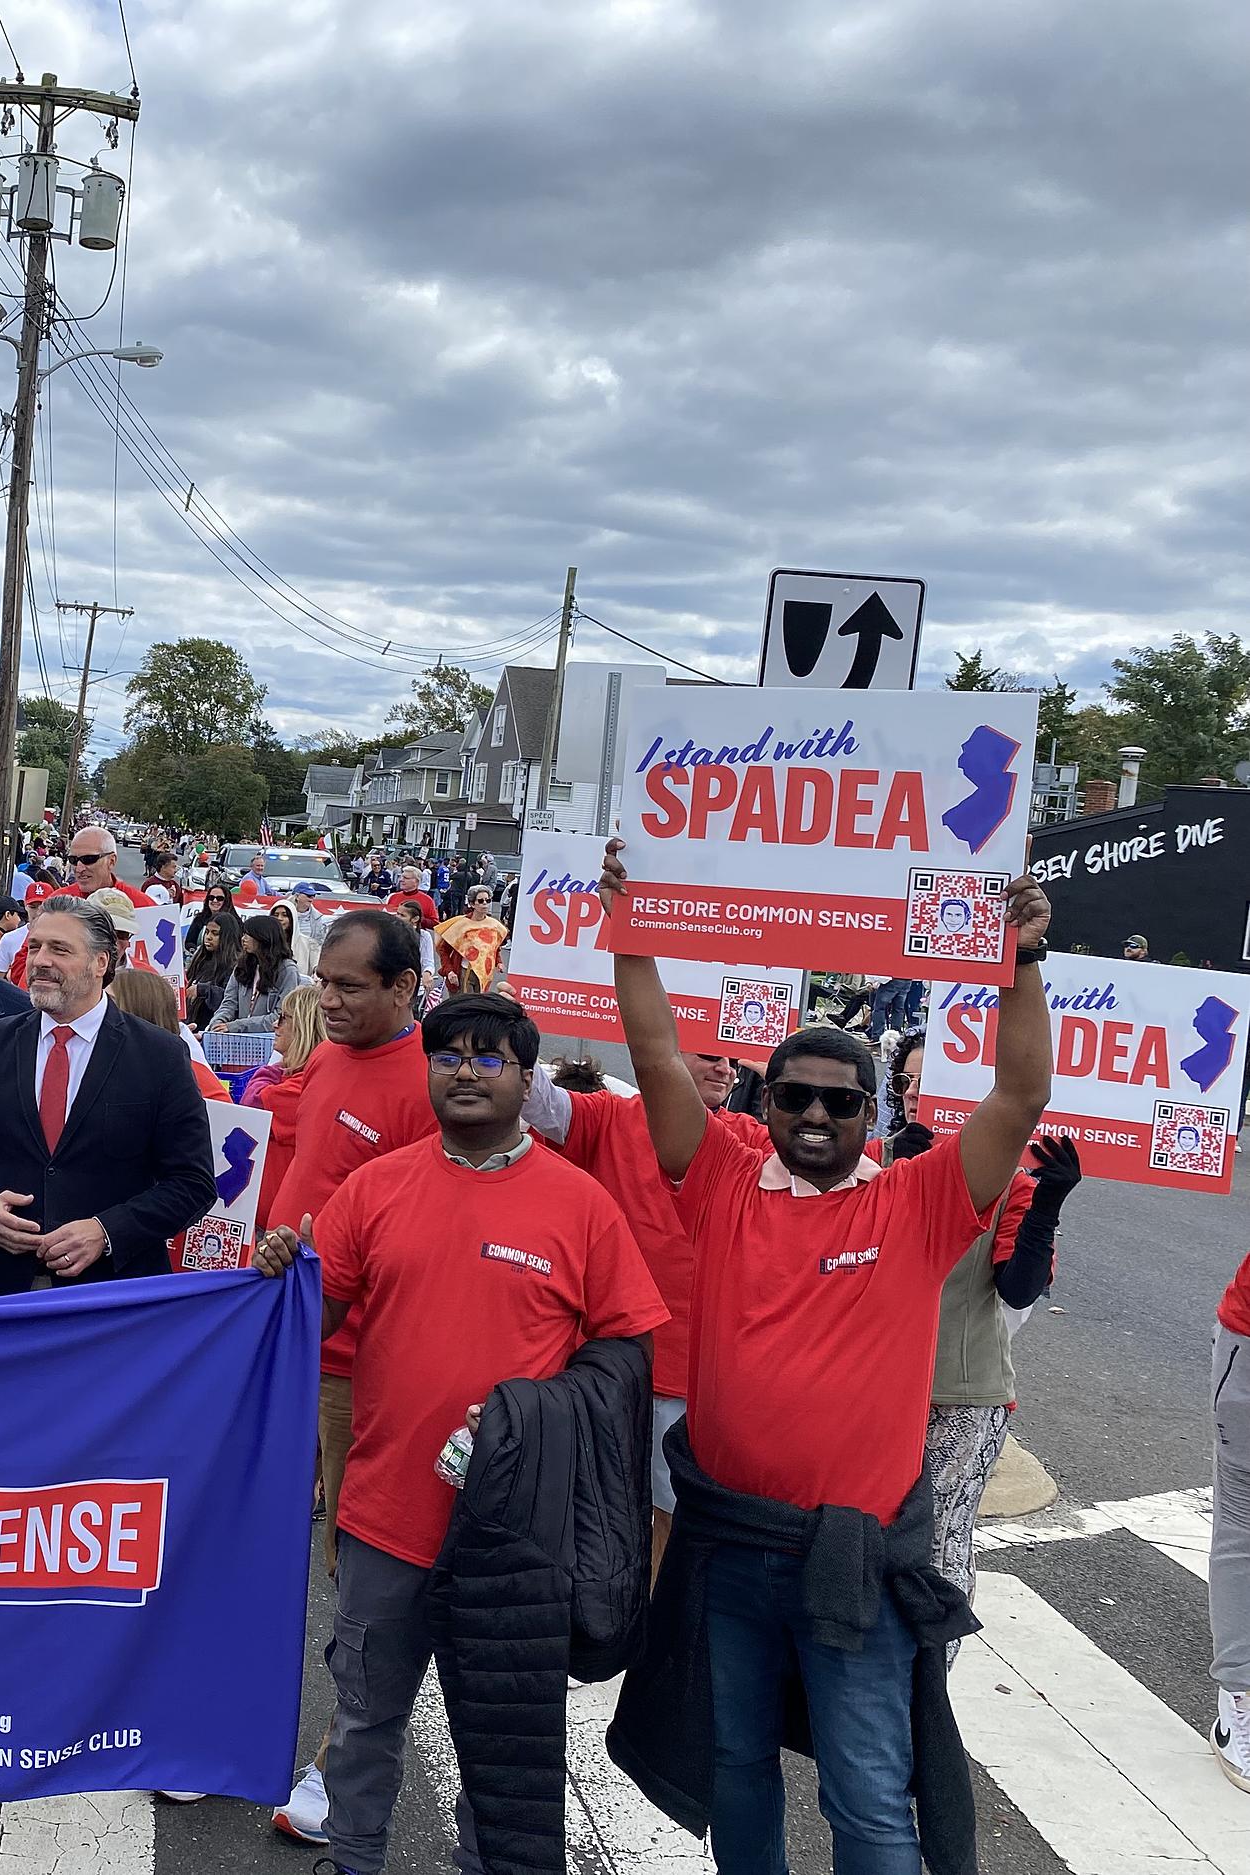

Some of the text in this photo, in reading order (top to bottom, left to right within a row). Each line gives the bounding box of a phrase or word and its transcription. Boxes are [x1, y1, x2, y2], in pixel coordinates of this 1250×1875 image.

[635, 720, 859, 773] I stand with
[641, 762, 930, 852] SPADEA
[1028, 817, 1225, 884] SEY SHORE DIVE
[526, 869, 600, 895] I stan
[630, 917, 763, 939] CommonSenseClub.org
[632, 897, 893, 932] RESTORE COMMON SENSE.
[520, 987, 710, 1023] RESTORE COM NSE.
[1051, 982, 1120, 1011] with
[943, 1002, 1170, 1089] SDEA
[339, 1110, 381, 1144] COMMON SENSE
[1033, 1122, 1142, 1149] MMON SENSE.
[488, 1244, 527, 1264] COMMON
[527, 1254, 552, 1273] SENSE
[827, 1252, 856, 1271] COMON
[19, 1740, 84, 1769] SENSE
[88, 1728, 142, 1751] CLUB
